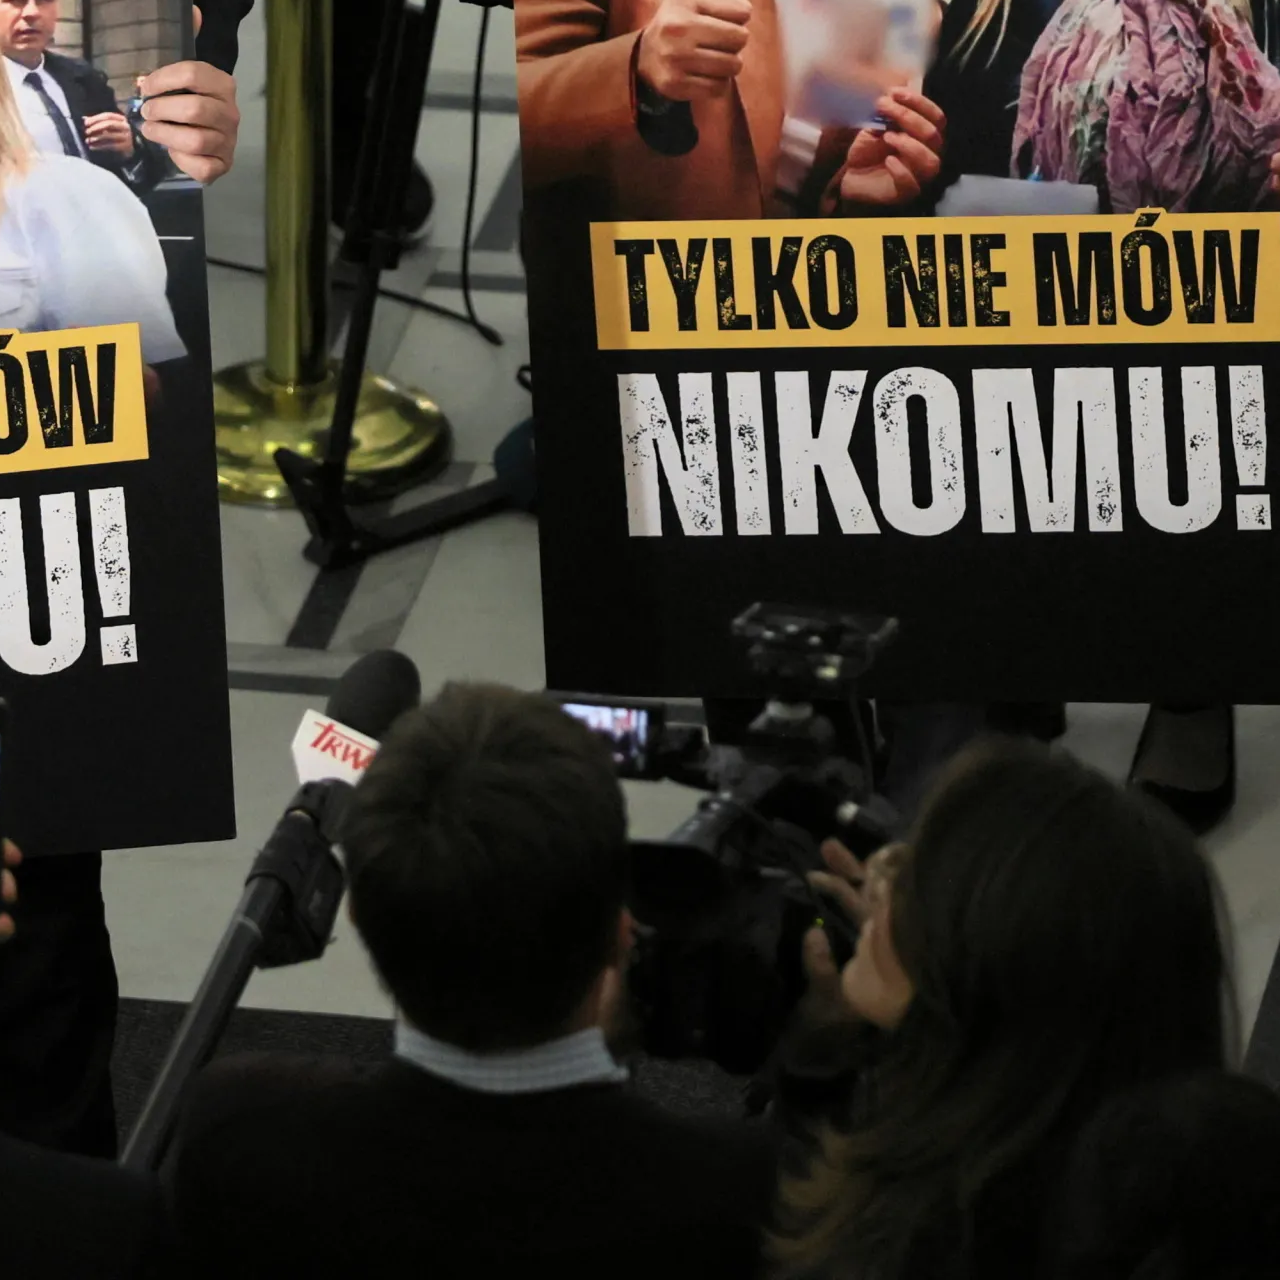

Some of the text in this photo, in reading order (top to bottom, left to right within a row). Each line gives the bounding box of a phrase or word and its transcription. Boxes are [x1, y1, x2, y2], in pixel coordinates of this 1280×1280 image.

[614, 211, 1260, 332] TYLKO NIE MÓW
[616, 365, 1273, 537] NIKOMU!
